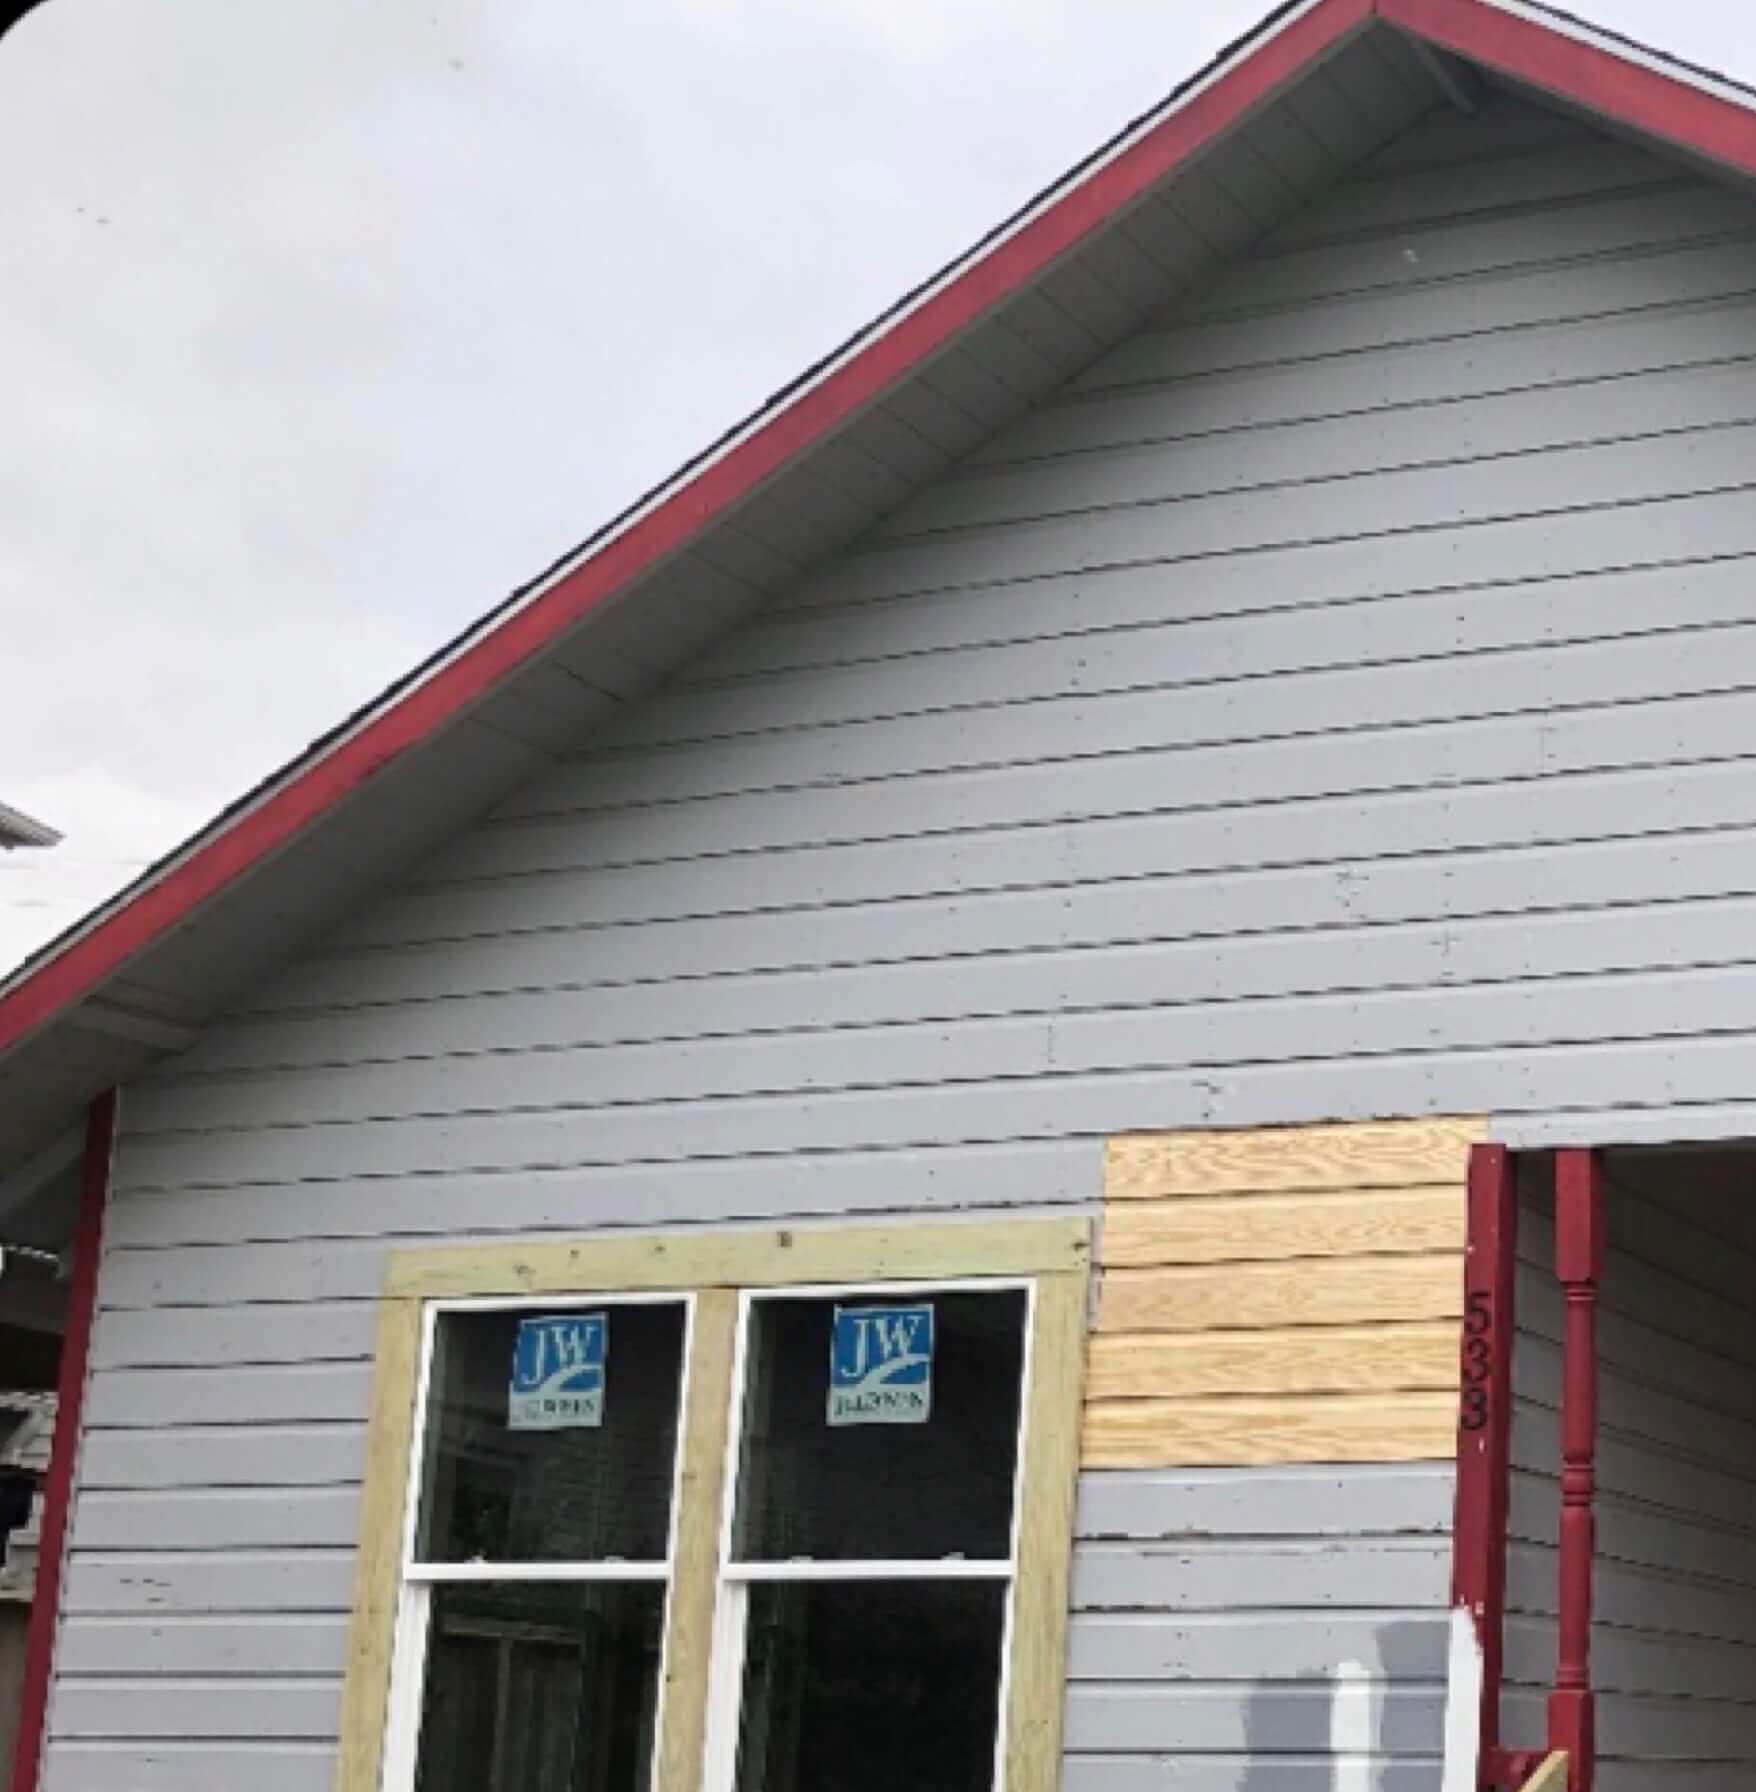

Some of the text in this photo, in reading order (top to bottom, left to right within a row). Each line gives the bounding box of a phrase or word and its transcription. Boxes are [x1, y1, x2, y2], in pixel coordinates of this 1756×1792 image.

[521, 1324, 598, 1385] JW
[840, 1315, 926, 1378] JW
[1461, 1290, 1491, 1431] 533
